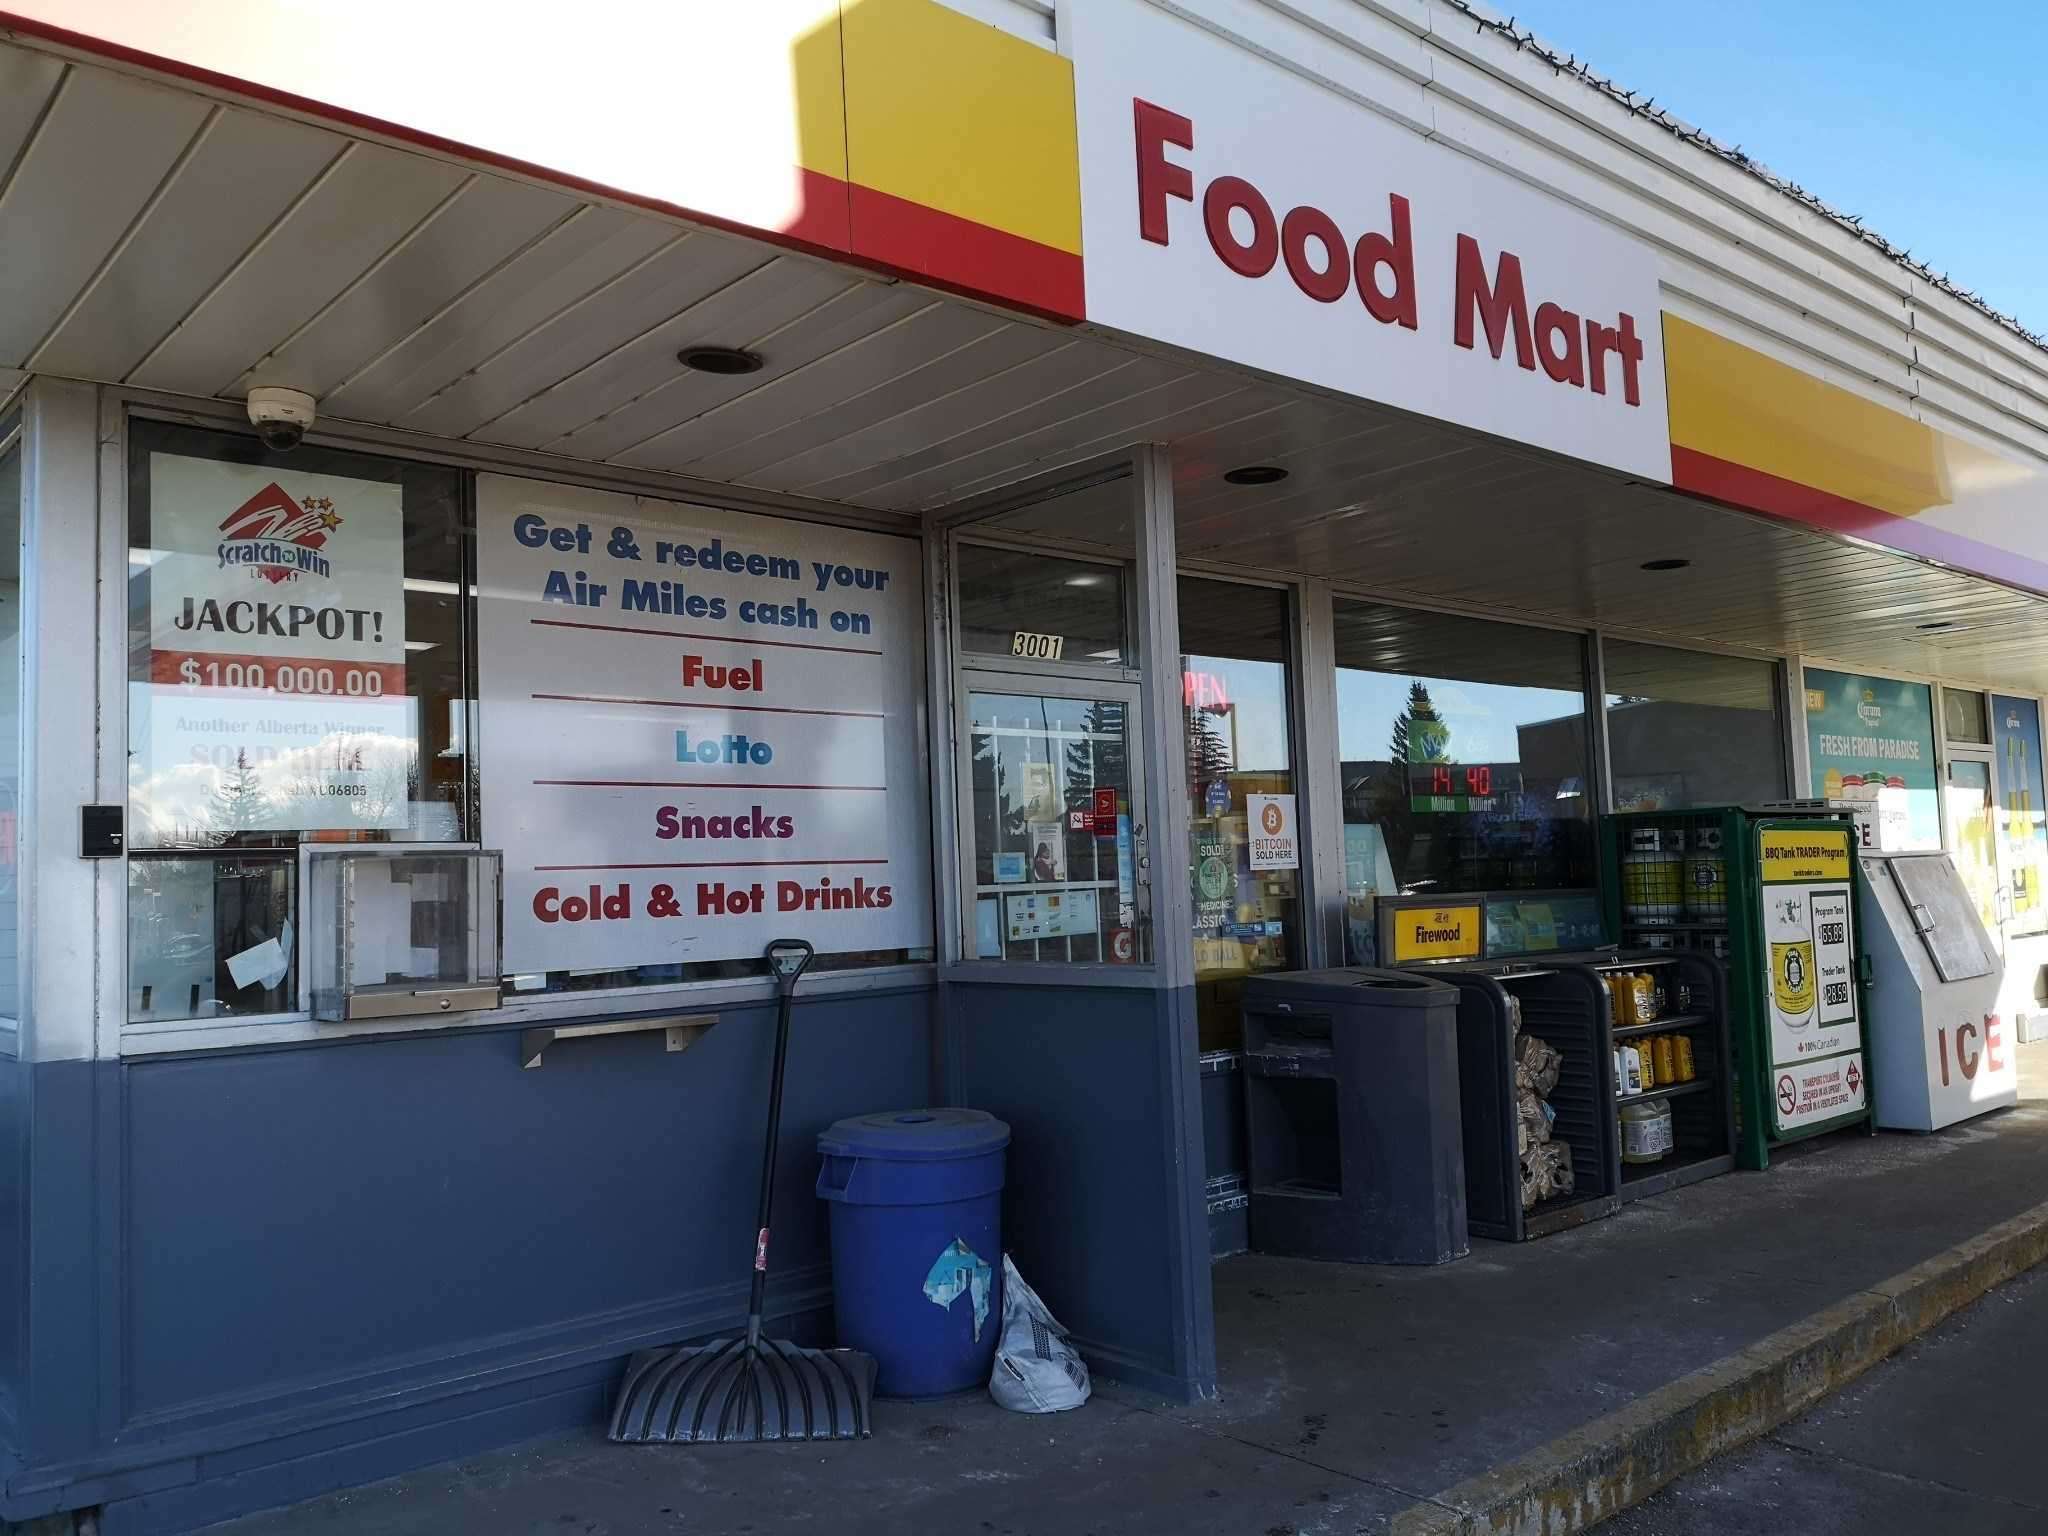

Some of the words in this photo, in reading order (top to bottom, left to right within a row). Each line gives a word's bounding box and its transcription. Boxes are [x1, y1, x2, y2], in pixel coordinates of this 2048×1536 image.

[1133, 97, 1418, 330] Food
[1453, 232, 1643, 407] Mart
[217, 541, 281, 570] Scratch
[296, 547, 330, 579] Win
[513, 512, 592, 554] Get
[606, 526, 641, 560] &
[655, 538, 800, 581] redeem
[811, 559, 890, 593] your
[173, 596, 383, 643] JACKPOT!
[542, 569, 607, 608] Air
[620, 578, 727, 620] Miles
[738, 598, 819, 629] cash
[829, 609, 871, 635] on
[1014, 633, 1061, 659] 3001
[179, 656, 383, 697] $100,000.00
[681, 655, 764, 692] Fuel
[1184, 671, 1227, 708] PEN
[175, 716, 250, 734] Another
[255, 719, 319, 736] Alberta
[324, 721, 385, 737] Winner
[675, 730, 773, 766] Lotto
[1819, 734, 1850, 756] FRESH
[1852, 736, 1878, 758] FROM
[1879, 738, 1920, 760] PARADISE
[1466, 766, 1491, 796] 40
[1431, 796, 1456, 812] Million
[655, 806, 795, 840] Snacks
[1255, 838, 1293, 850] BITCOIN
[1255, 850, 1274, 860] SOLD
[1275, 849, 1293, 860] HERE
[1765, 847, 1780, 861] BBQ
[1780, 846, 1796, 860] Tank
[1795, 846, 1822, 859] TRADER
[1821, 847, 1845, 861] Program
[533, 882, 631, 923] Cold
[646, 883, 683, 918] &
[696, 882, 765, 917] Hot
[777, 877, 893, 911] Drinks
[1415, 922, 1461, 945] Firewood
[1937, 1012, 2005, 1088] ICE
